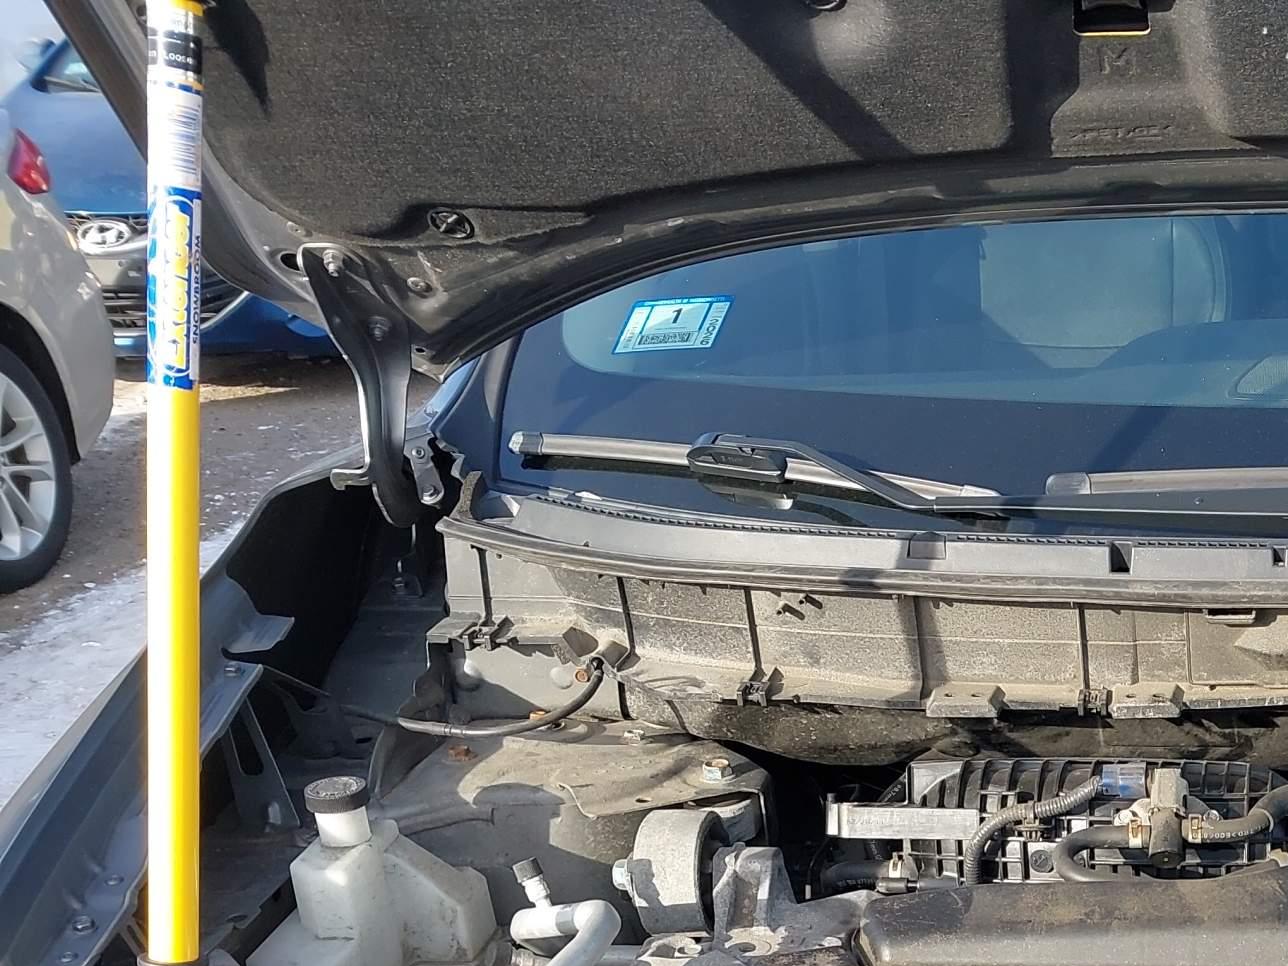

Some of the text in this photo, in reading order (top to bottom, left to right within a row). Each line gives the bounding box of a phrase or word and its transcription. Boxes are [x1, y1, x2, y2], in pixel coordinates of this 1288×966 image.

[191, 234, 201, 346] SNOWBROOM
[672, 307, 683, 324] 1
[700, 319, 719, 346] 2026
